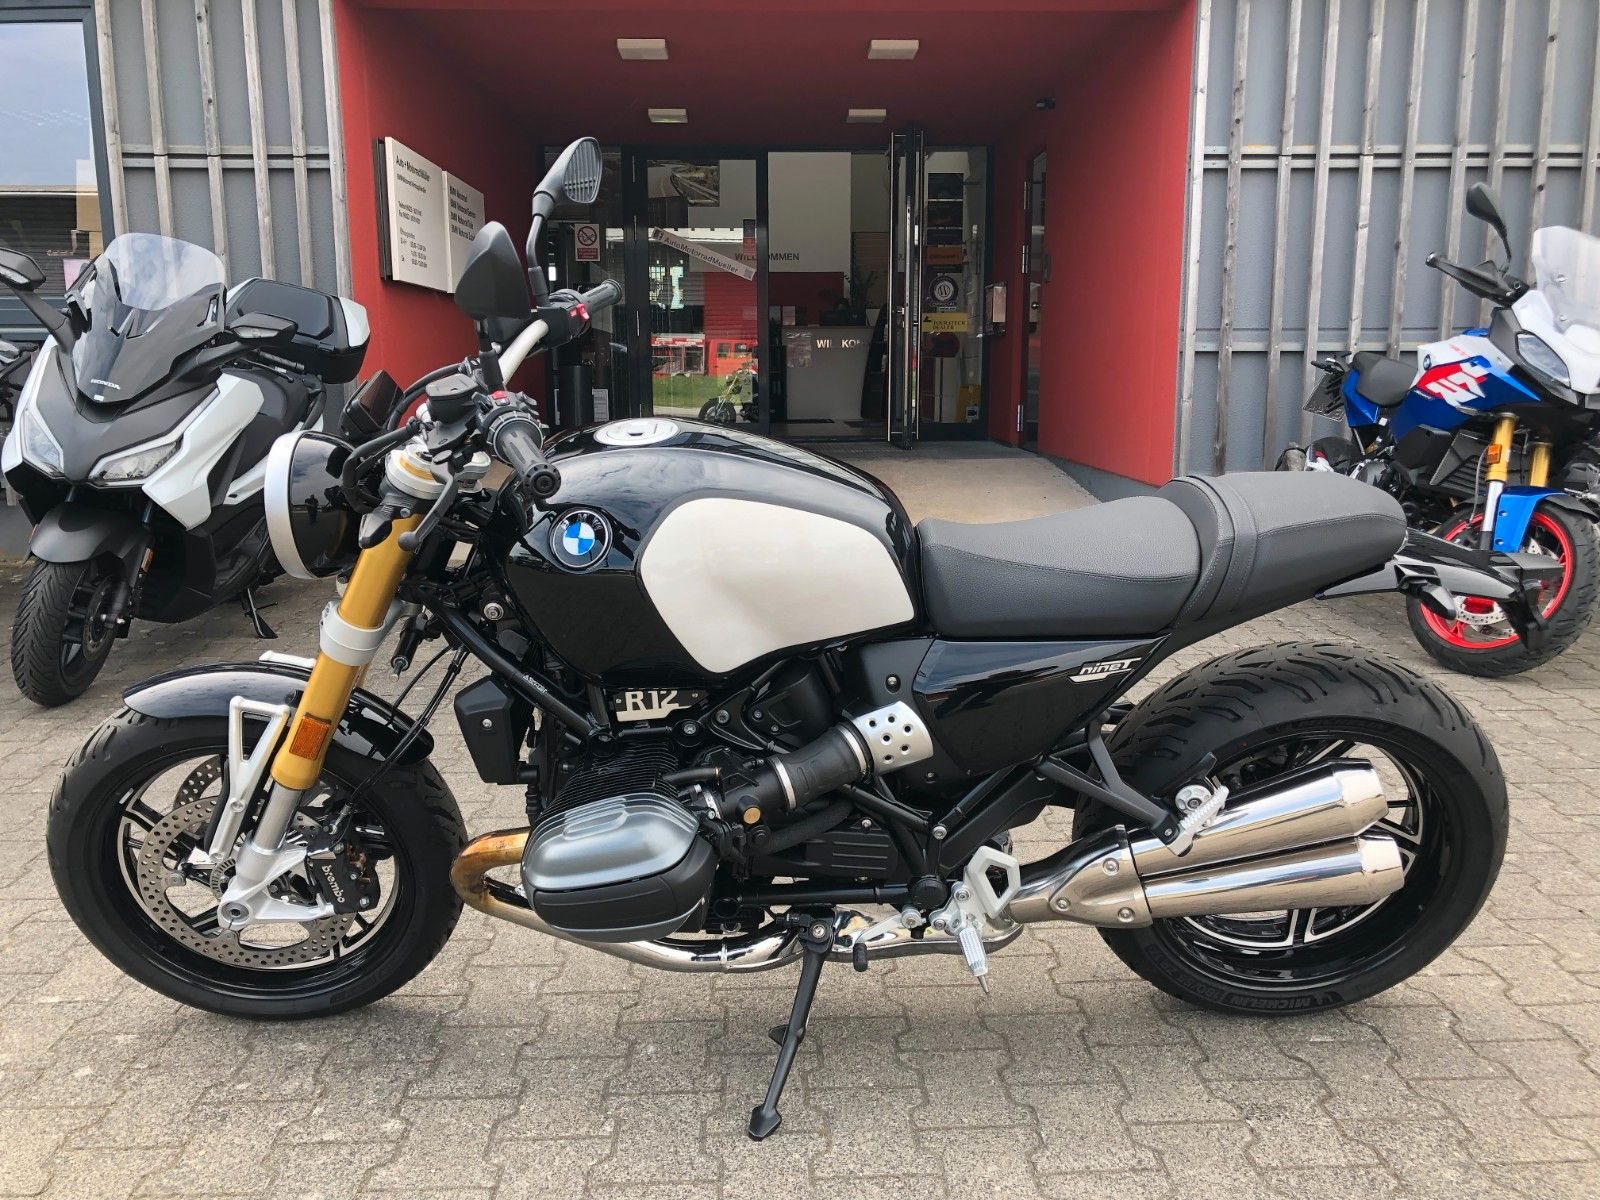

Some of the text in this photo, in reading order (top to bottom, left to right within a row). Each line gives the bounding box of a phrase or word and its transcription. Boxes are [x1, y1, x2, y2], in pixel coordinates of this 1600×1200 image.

[90, 378, 121, 390] HONDA
[560, 513, 604, 531] BMW
[321, 864, 346, 903] brembo
[1230, 994, 1312, 1009] MICHELIN
